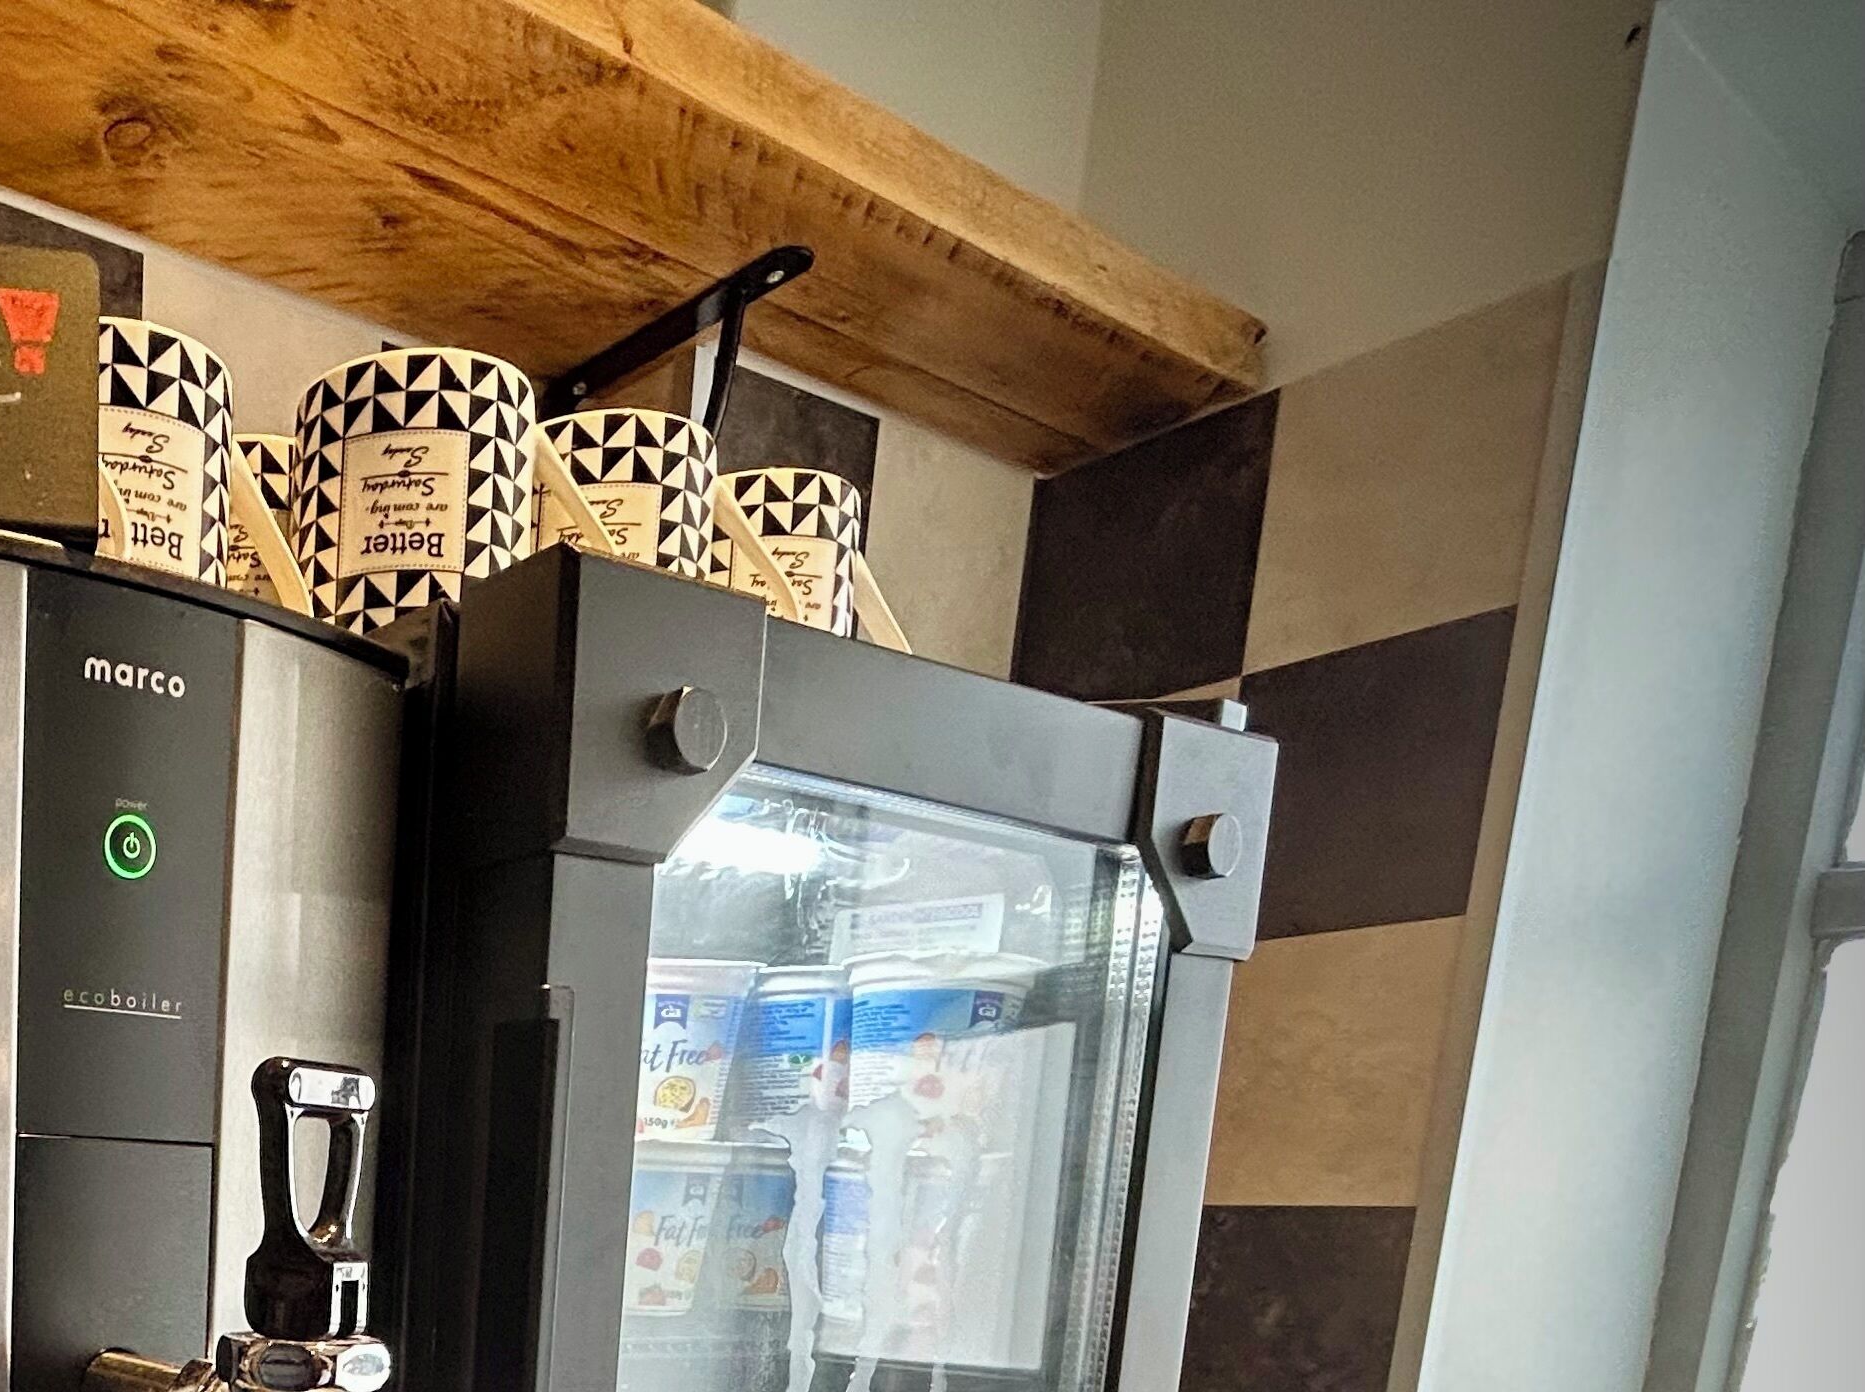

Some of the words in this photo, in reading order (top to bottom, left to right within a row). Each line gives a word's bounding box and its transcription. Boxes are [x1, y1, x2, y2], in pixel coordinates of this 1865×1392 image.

[361, 477, 435, 496] Saturday
[425, 503, 448, 511] are
[360, 532, 445, 558] Better
[84, 655, 186, 699] marco
[63, 988, 182, 1012] ecoboiler
